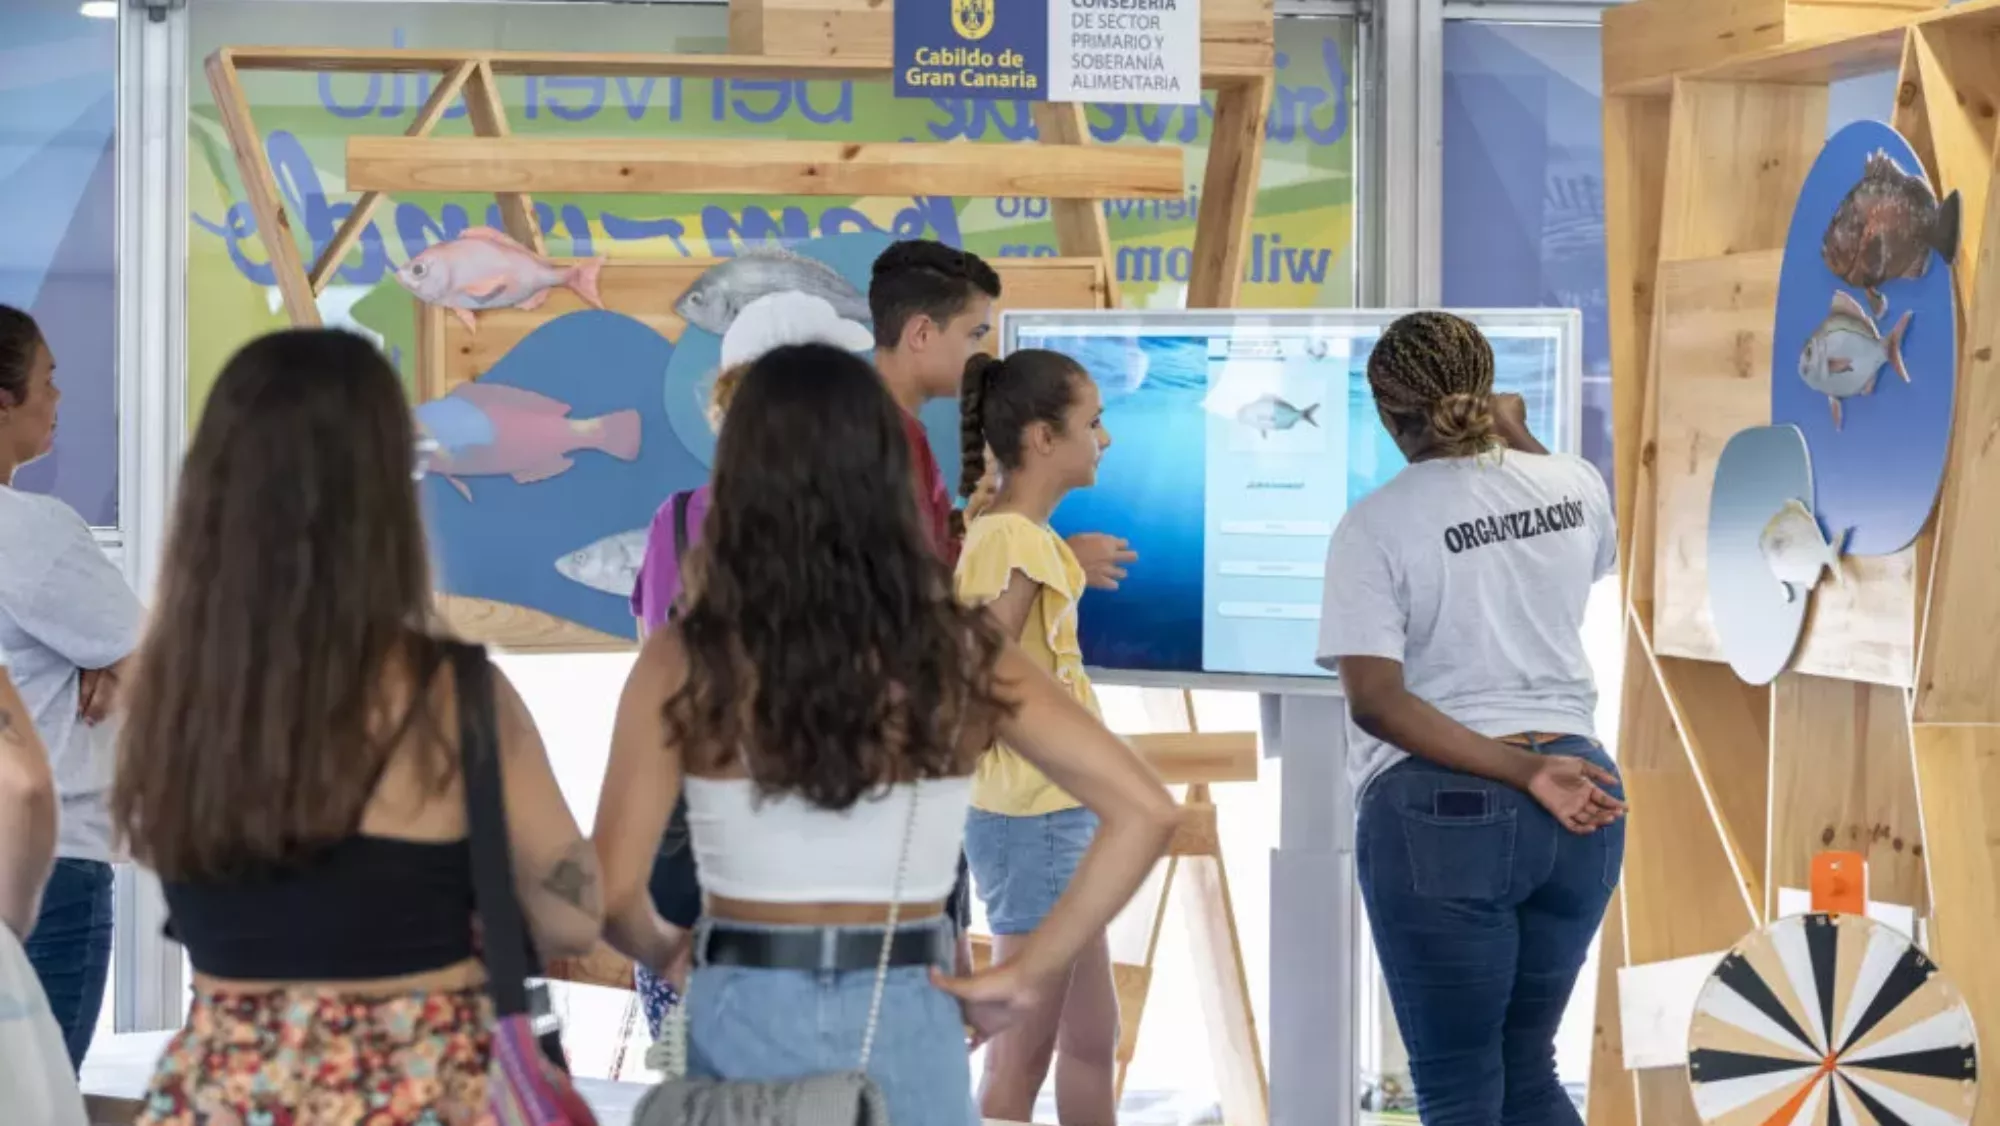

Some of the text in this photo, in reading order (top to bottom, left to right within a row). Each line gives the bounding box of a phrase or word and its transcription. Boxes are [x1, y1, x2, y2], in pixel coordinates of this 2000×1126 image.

[1071, 12, 1161, 31] DE SECTOR
[1071, 33, 1164, 51] PRIMARIO Y
[915, 46, 1024, 68] Cabildo de
[1071, 52, 1165, 71] SOBERANÍA
[905, 67, 1038, 89] Gran Canaria
[1072, 74, 1181, 91] ALIMENTARIA
[1444, 494, 1586, 554] ORGANIZACIÓN
